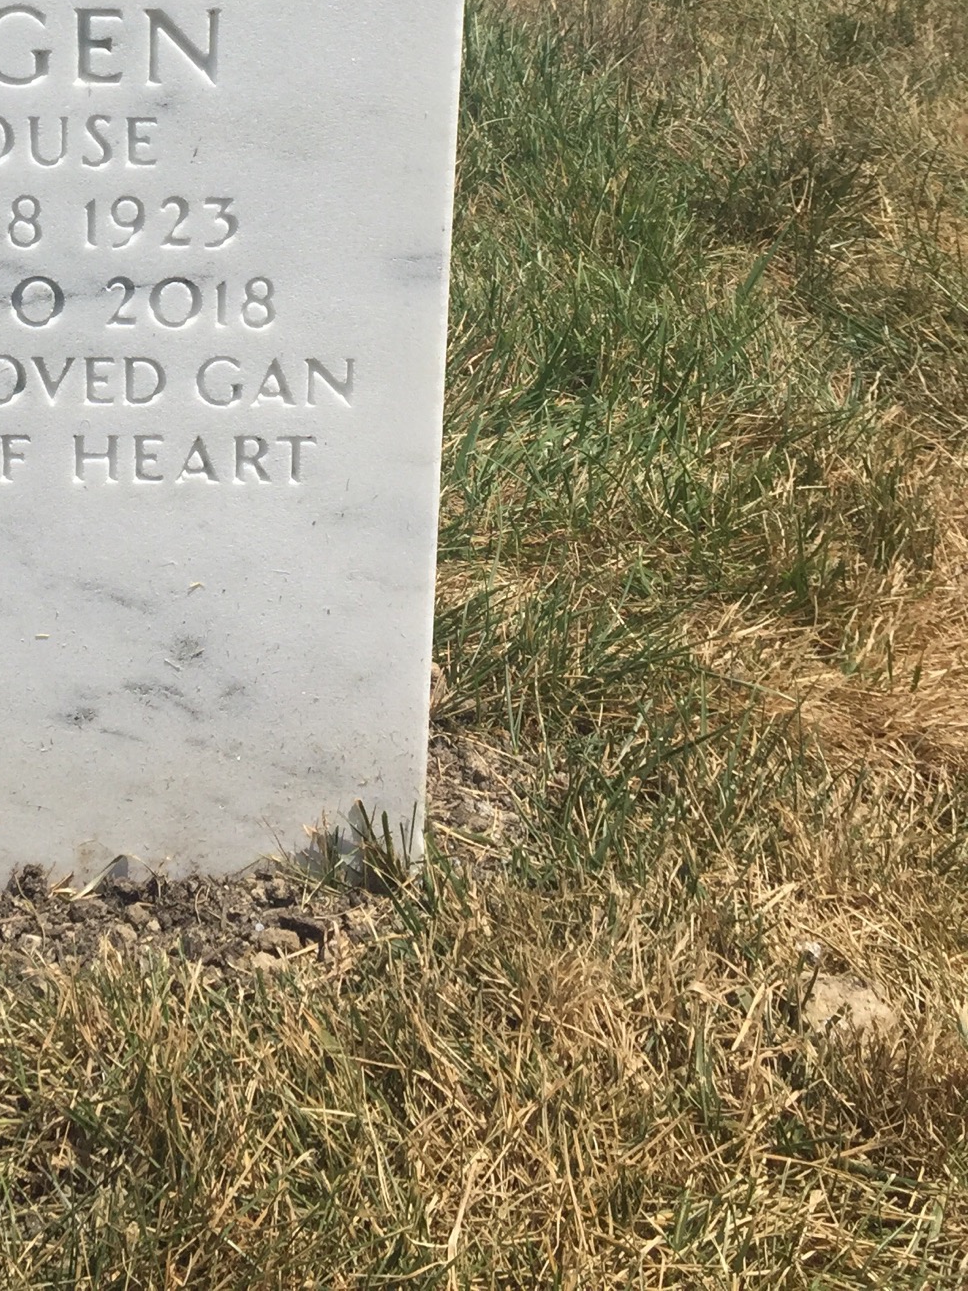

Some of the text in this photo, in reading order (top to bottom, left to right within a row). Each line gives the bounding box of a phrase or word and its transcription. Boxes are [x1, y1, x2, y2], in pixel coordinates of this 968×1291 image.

[7, 194, 43, 250] 8
[83, 195, 241, 250] 1923
[105, 275, 278, 330] 2018
[195, 356, 357, 408] GAN
[72, 434, 318, 486] HEART
